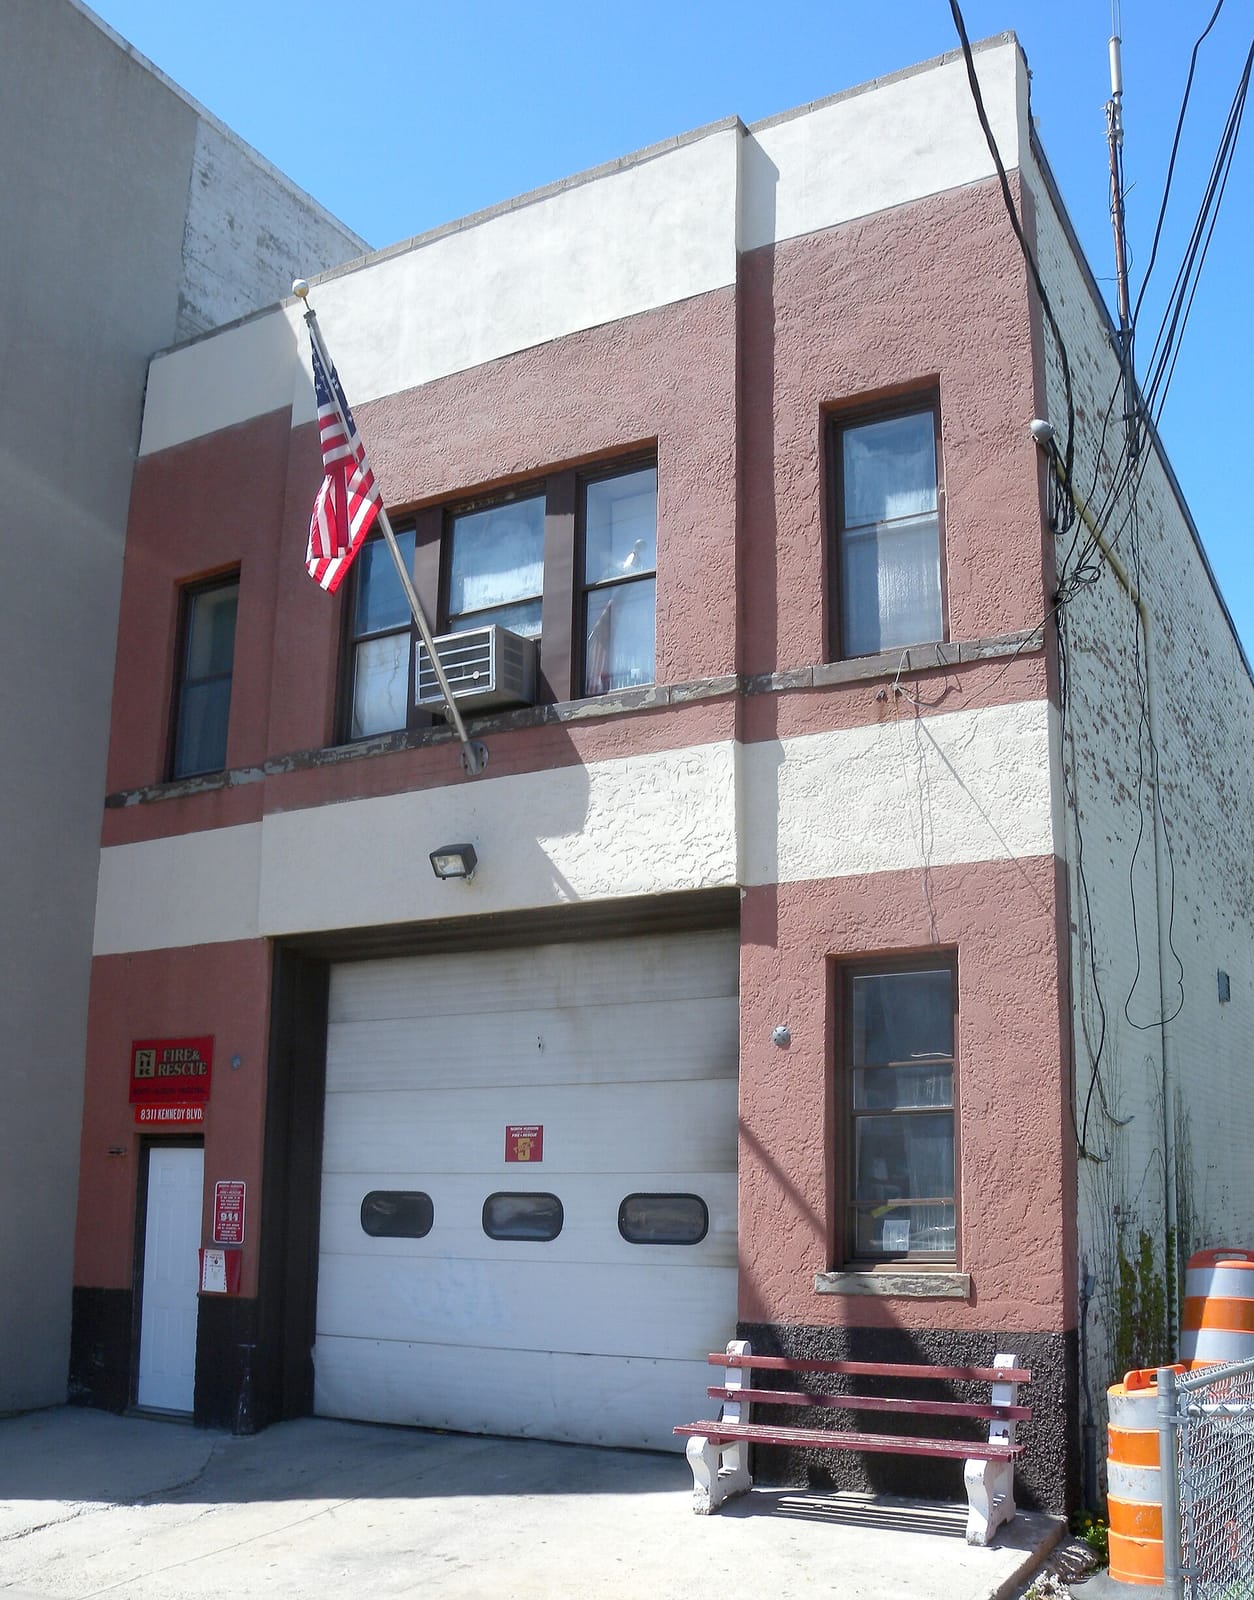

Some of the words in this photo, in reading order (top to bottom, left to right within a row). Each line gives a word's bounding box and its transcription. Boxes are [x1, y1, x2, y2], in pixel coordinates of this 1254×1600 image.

[158, 1063, 207, 1076] RESCUE
[140, 1108, 157, 1120] 8311
[157, 1108, 186, 1120] KENNEDY
[220, 1212, 239, 1221] 911
